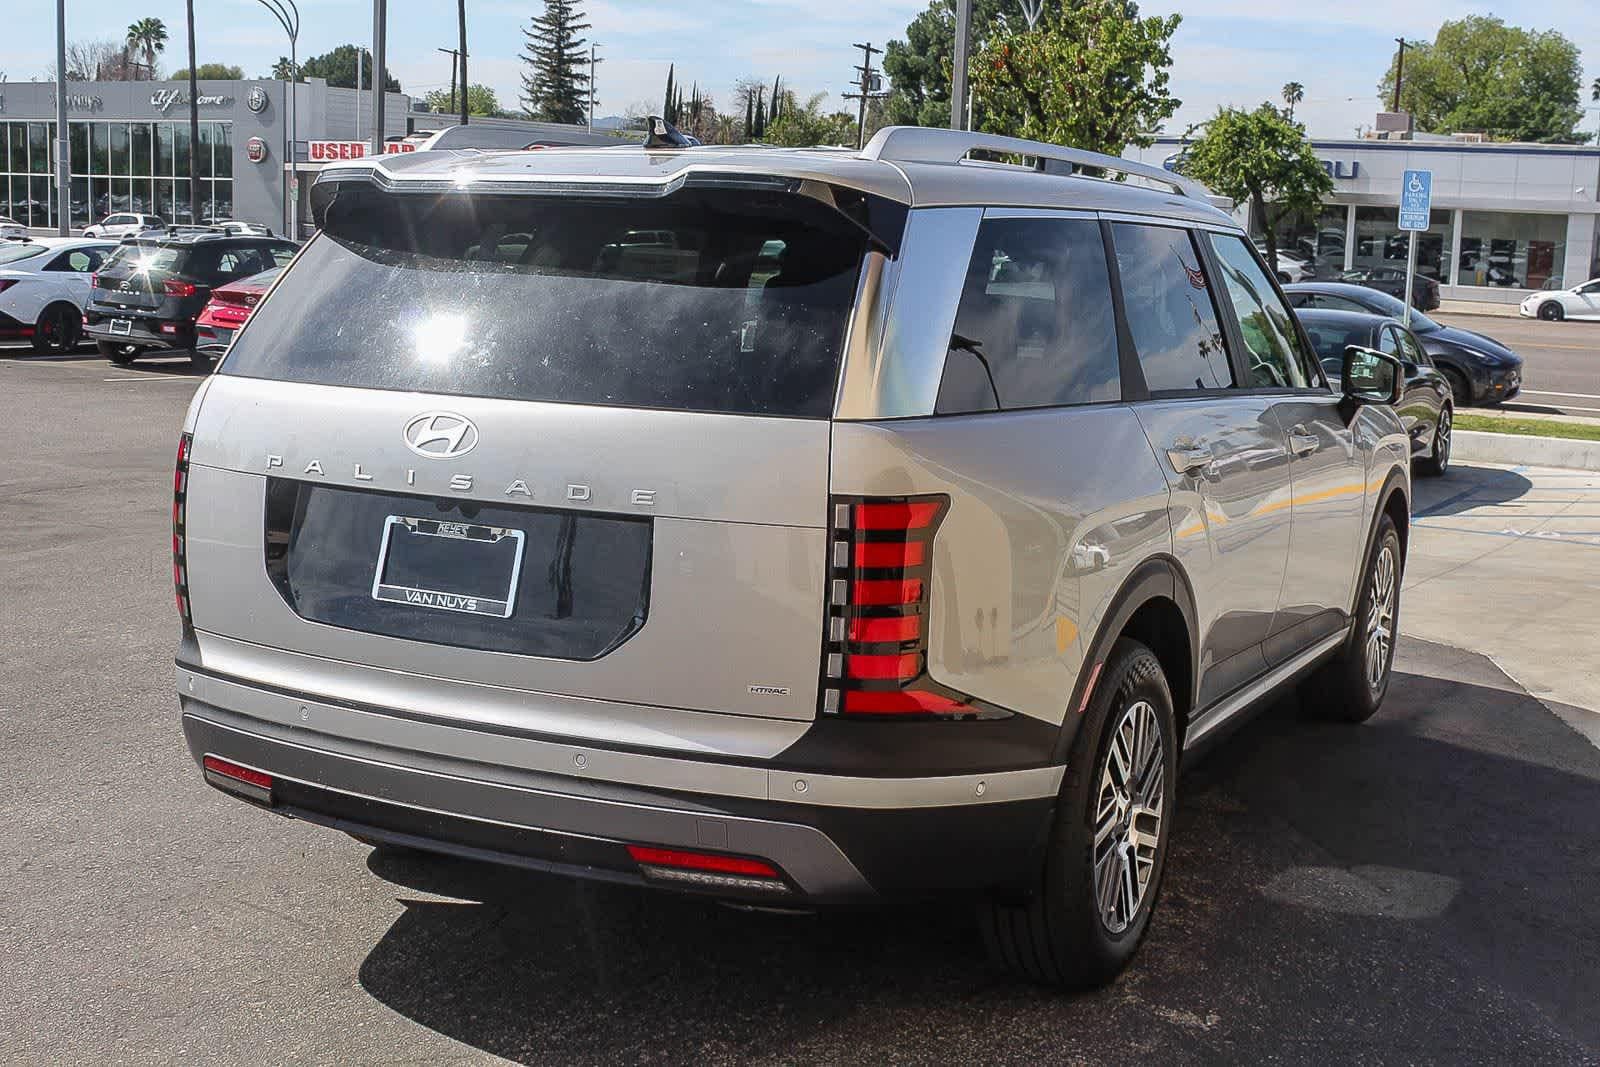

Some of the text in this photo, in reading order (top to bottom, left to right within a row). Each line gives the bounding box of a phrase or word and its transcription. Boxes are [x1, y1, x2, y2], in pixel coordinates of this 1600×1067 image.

[312, 143, 364, 160] USED
[266, 454, 657, 506] PALISADE
[437, 522, 470, 538] KEYES
[405, 590, 478, 611] VAN NUYS
[750, 686, 788, 695] HTRAC
